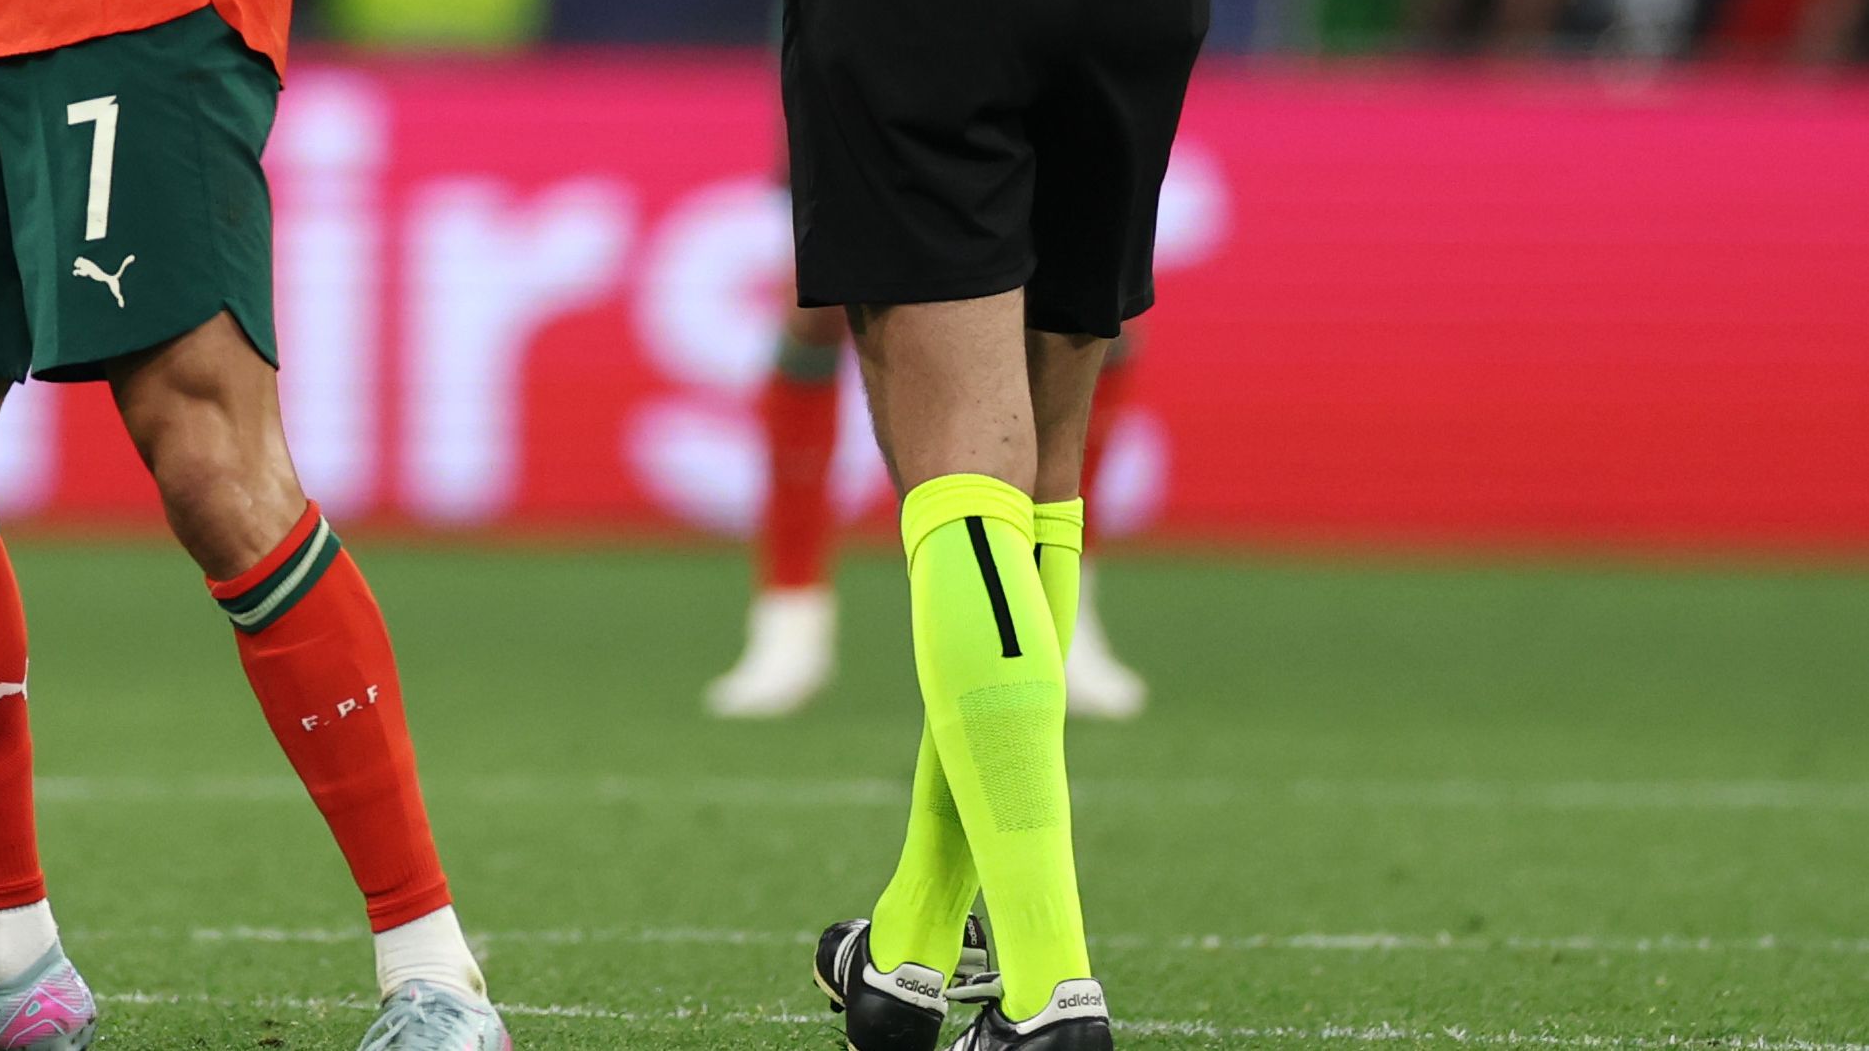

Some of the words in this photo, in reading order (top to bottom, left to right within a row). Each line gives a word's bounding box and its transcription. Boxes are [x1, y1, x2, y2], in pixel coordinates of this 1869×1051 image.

[66, 94, 120, 242] 7
[895, 977, 940, 999] adidas
[1057, 993, 1102, 1010] adidas
